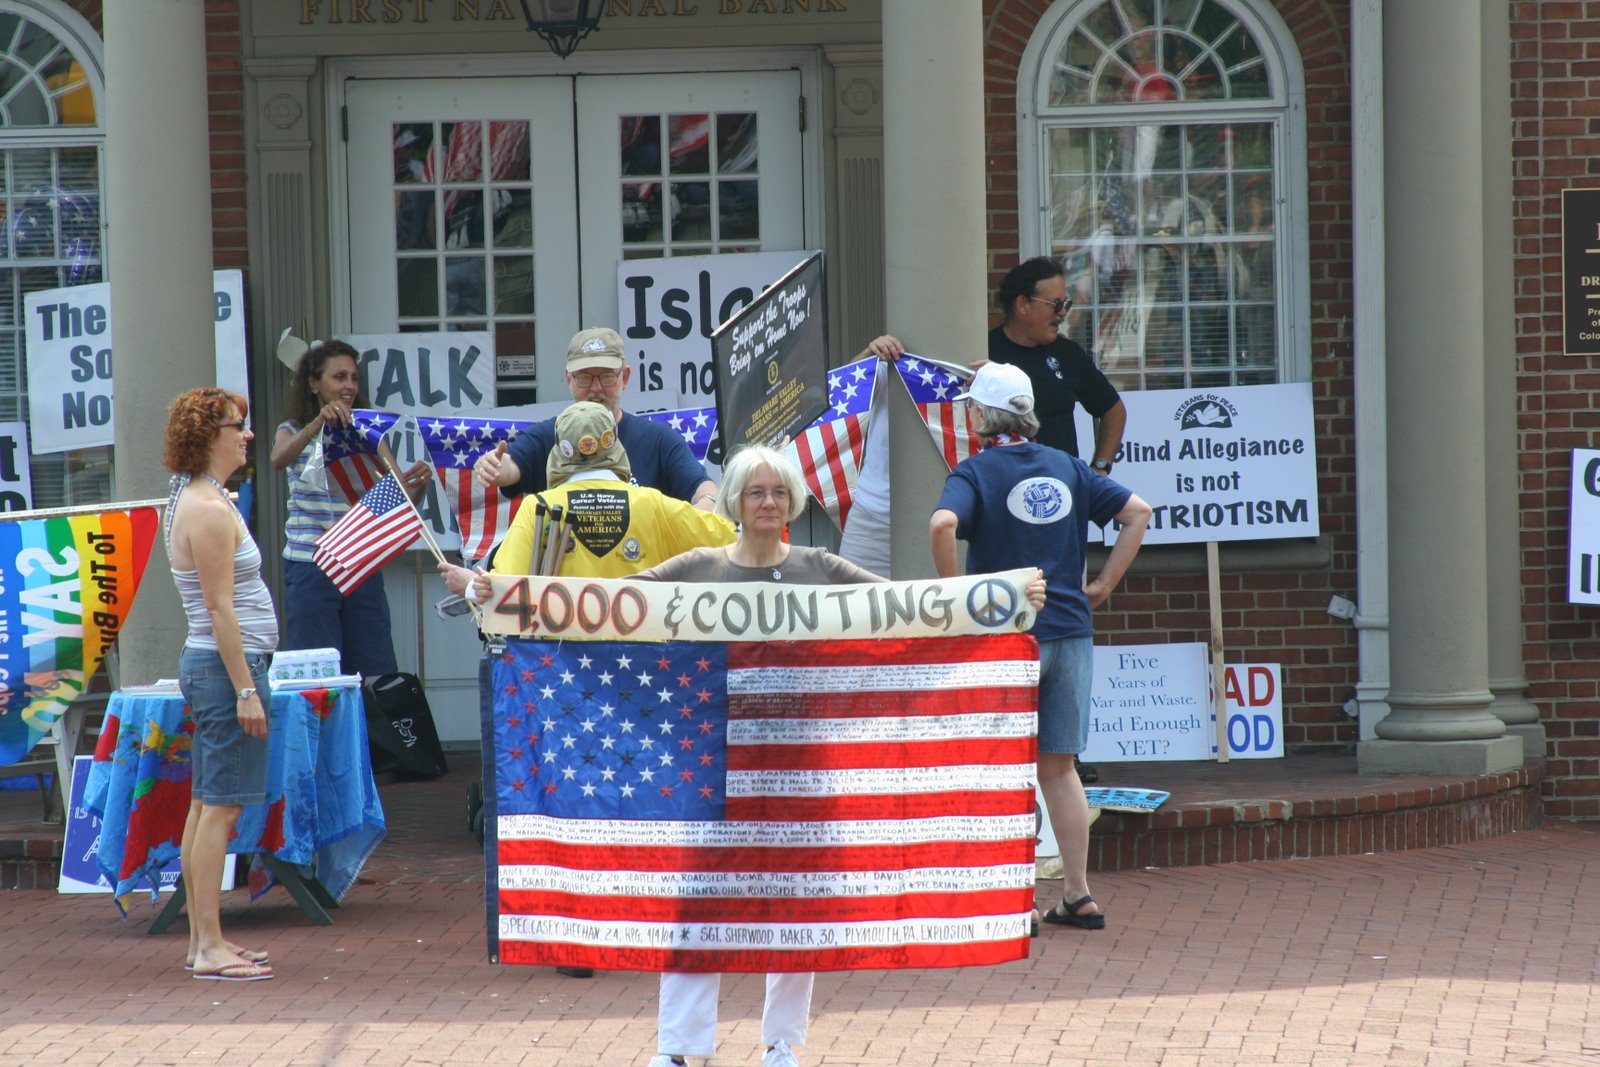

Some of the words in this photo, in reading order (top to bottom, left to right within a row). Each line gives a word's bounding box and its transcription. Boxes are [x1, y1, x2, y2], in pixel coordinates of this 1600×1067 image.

[299, 0, 433, 24] FIRST
[452, 0, 697, 20] NANAL
[36, 302, 107, 341] The
[732, 311, 765, 352] Support
[766, 300, 779, 326] the
[779, 284, 807, 314] Troops
[729, 351, 752, 376] Bring
[765, 323, 787, 348] Home
[638, 350, 664, 392] is
[745, 410, 773, 439] VETERANS
[780, 382, 805, 410] AMERICA
[752, 394, 779, 424] DELAWARE
[779, 377, 797, 400] VALLEY
[1173, 394, 1204, 421] VETERANS
[1220, 397, 1239, 417] PEACE
[1178, 437, 1305, 462] Allegiance
[1176, 473, 1195, 493] is
[1201, 471, 1241, 492] not
[1113, 499, 1309, 532] TRIOTISM
[577, 526, 623, 534] AMERICA
[494, 577, 648, 636] 4,000
[1117, 653, 1160, 670] Five
[1108, 676, 1147, 689] Years
[1151, 674, 1166, 688] of
[1119, 694, 1147, 708] and
[1150, 694, 1198, 707] Waste.
[1088, 716, 1124, 733] Had
[1129, 714, 1202, 735] Enough
[1116, 739, 1171, 756] YET?
[522, 877, 547, 889] BRAD
[612, 885, 674, 896] MIDDLEBURG
[748, 886, 797, 896] ROADSIDE
[842, 884, 867, 895] JUNE
[681, 873, 729, 883] ROADSIDE
[768, 873, 796, 883] JUNE
[874, 871, 904, 880] DAVID
[531, 919, 559, 936] CASEY
[700, 928, 722, 944] SGT.
[724, 928, 774, 945] SHERWOOD
[780, 928, 814, 944] BAKER
[921, 923, 975, 942] EXPLOSION
[984, 918, 1027, 938] 4/26/04
